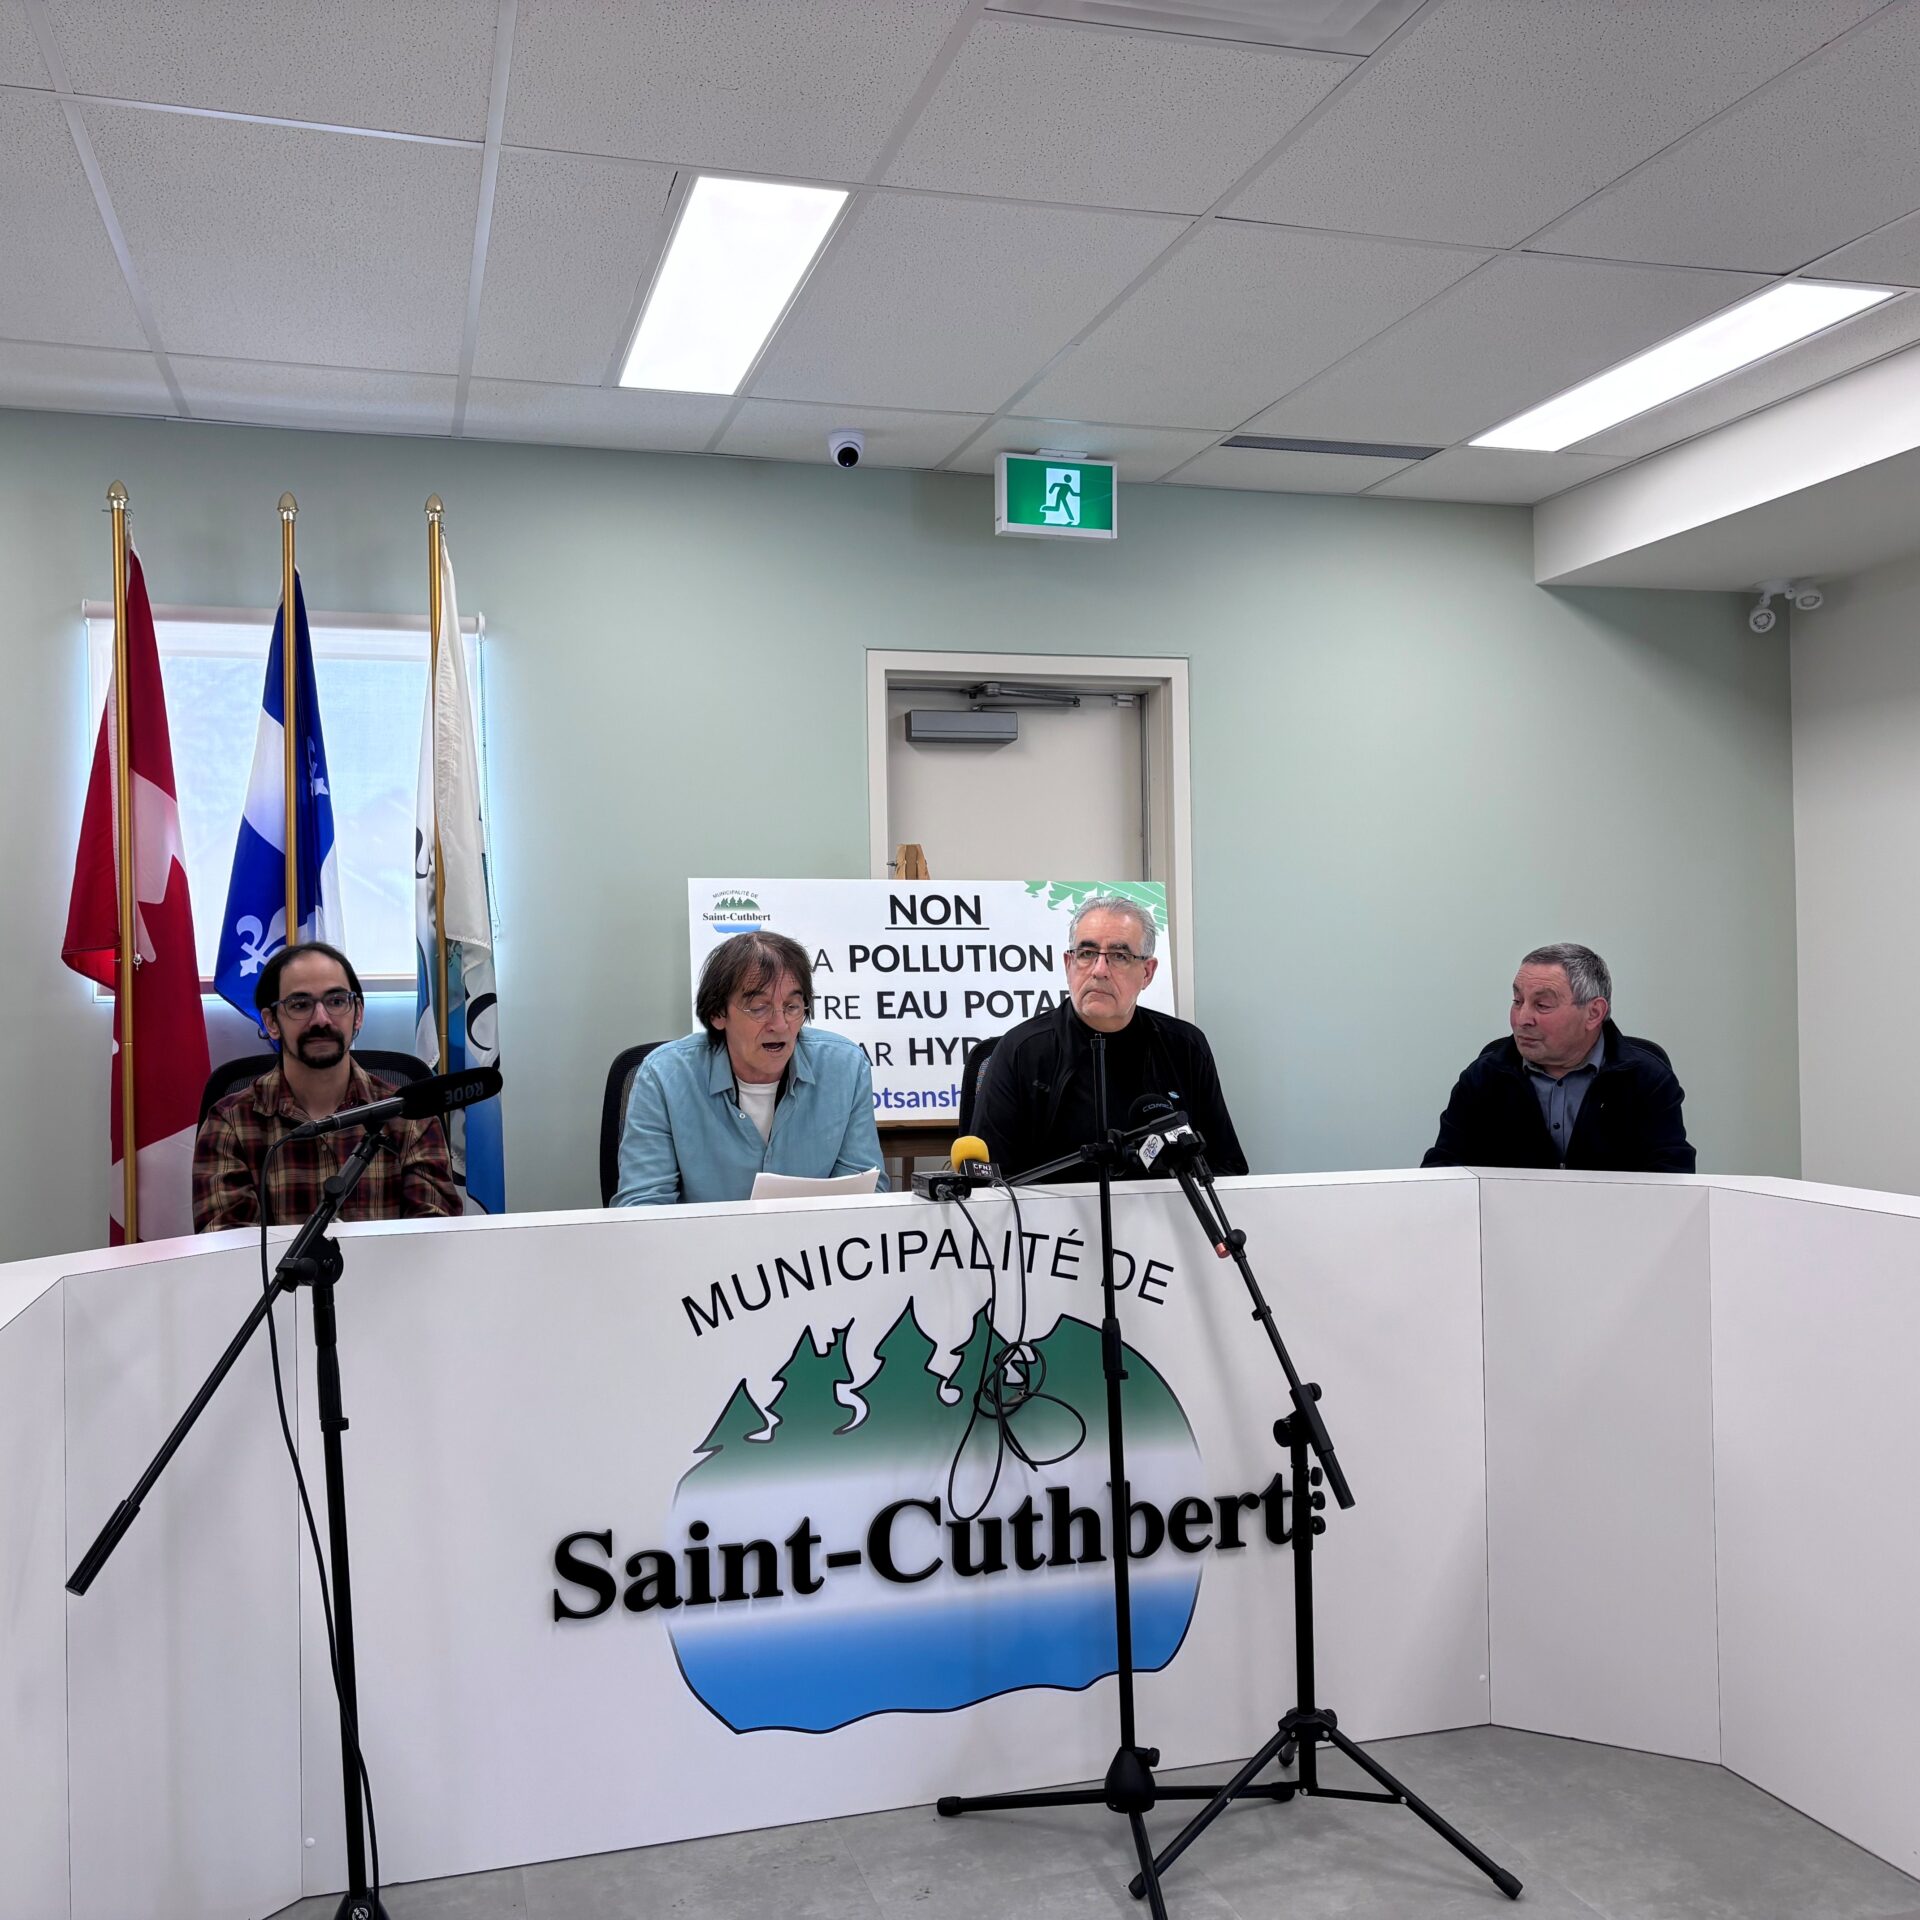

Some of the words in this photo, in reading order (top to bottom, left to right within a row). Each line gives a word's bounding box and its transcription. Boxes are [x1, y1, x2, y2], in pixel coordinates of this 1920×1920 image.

[712, 889, 749, 899] MUNICIPALITÉ
[702, 912, 771, 921] Saint-Cuthbert
[889, 894, 982, 926] NON
[811, 948, 834, 973] A
[848, 944, 1054, 973] POLLUTION
[811, 995, 861, 1020] TRE
[876, 990, 948, 1019] EAU
[964, 990, 1070, 1018] POTA
[908, 1036, 984, 1067] HYD
[872, 1084, 961, 1109] otsansh
[681, 1228, 1085, 1337] MUNICIPALITÉ
[1101, 1248, 1174, 1305] DE
[552, 1472, 1294, 1623] Saint-Cuthbert
